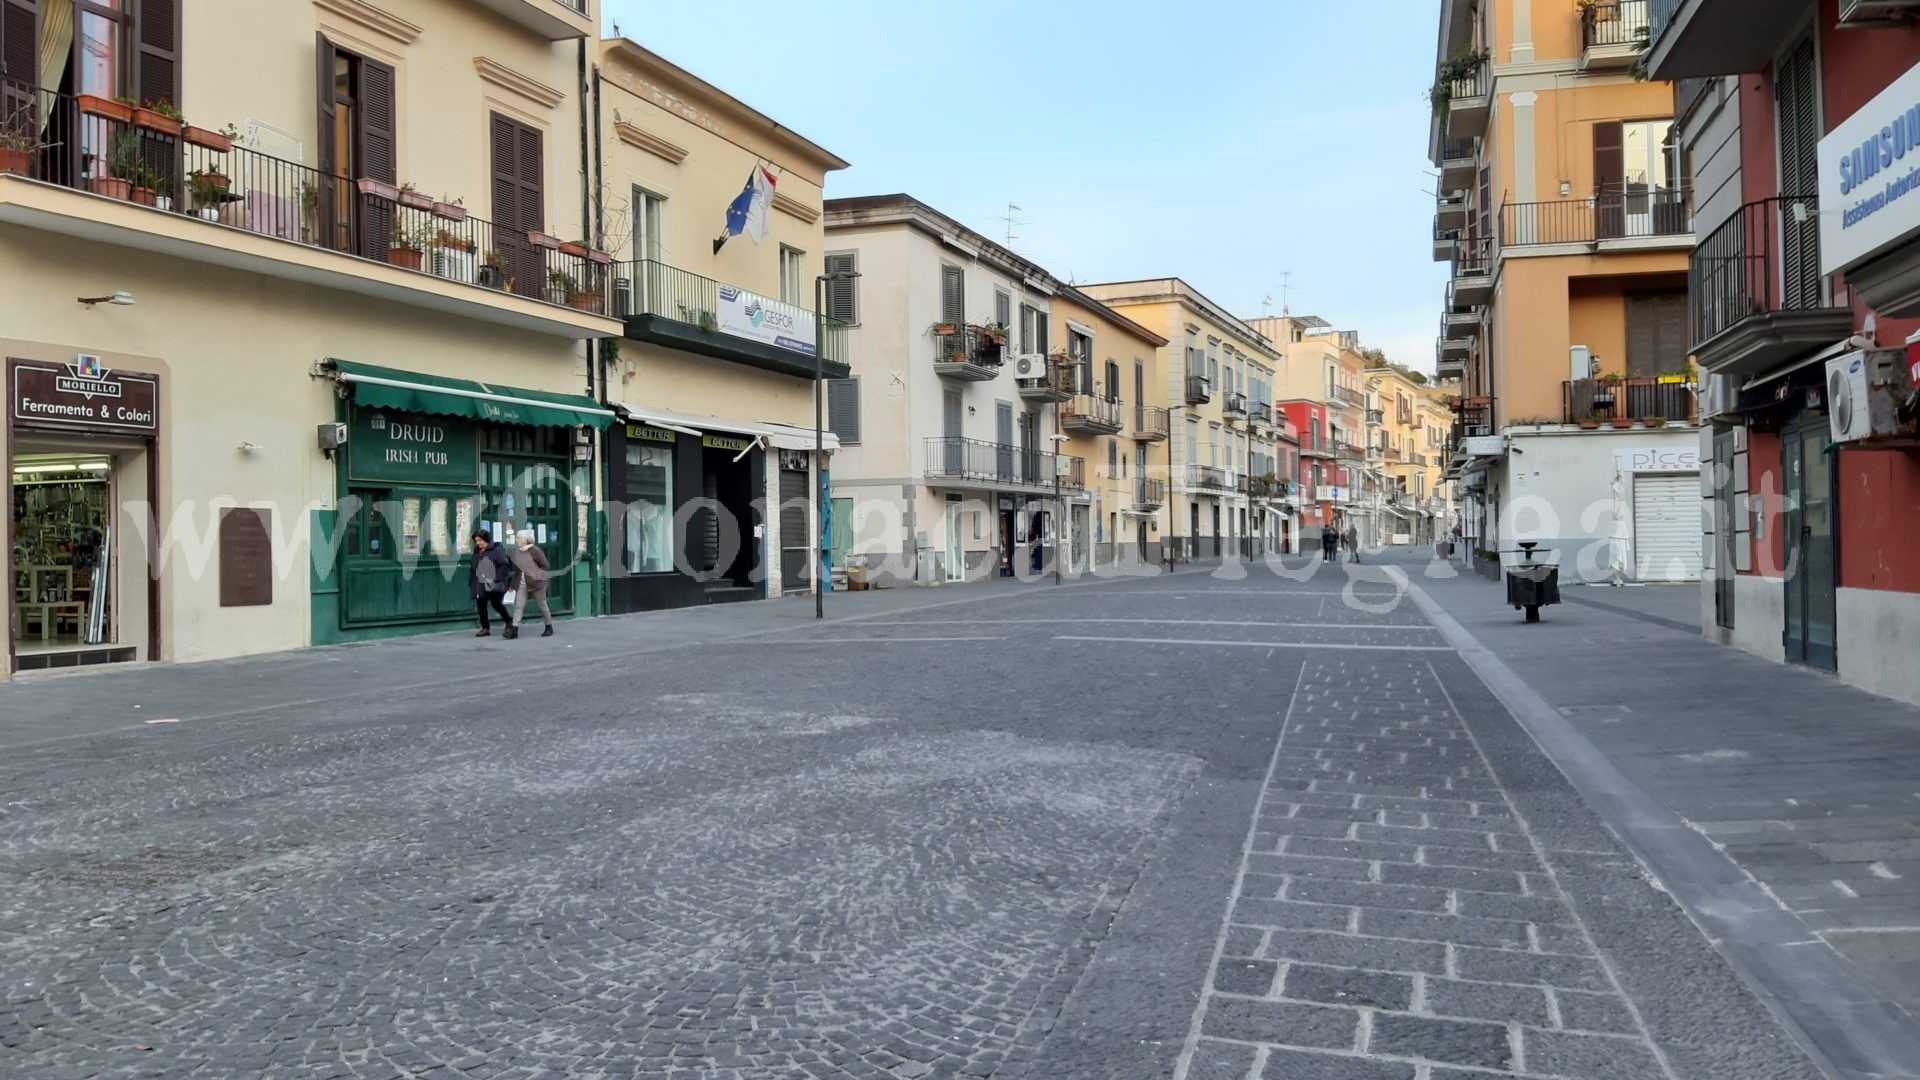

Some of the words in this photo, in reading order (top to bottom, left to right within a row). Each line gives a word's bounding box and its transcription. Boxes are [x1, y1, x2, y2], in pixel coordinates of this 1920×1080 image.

[1842, 190, 1885, 230] Assistenza
[764, 309, 794, 329] GESFOR
[62, 380, 116, 393] MORIELLO
[22, 397, 93, 417] Ferramenta
[100, 404, 110, 418] &
[116, 406, 151, 422] Colori
[390, 422, 444, 443] DRUID
[634, 427, 670, 439] BETTER
[711, 437, 743, 448] BETTER
[385, 448, 418, 464] IRISH
[425, 451, 448, 465] PUB
